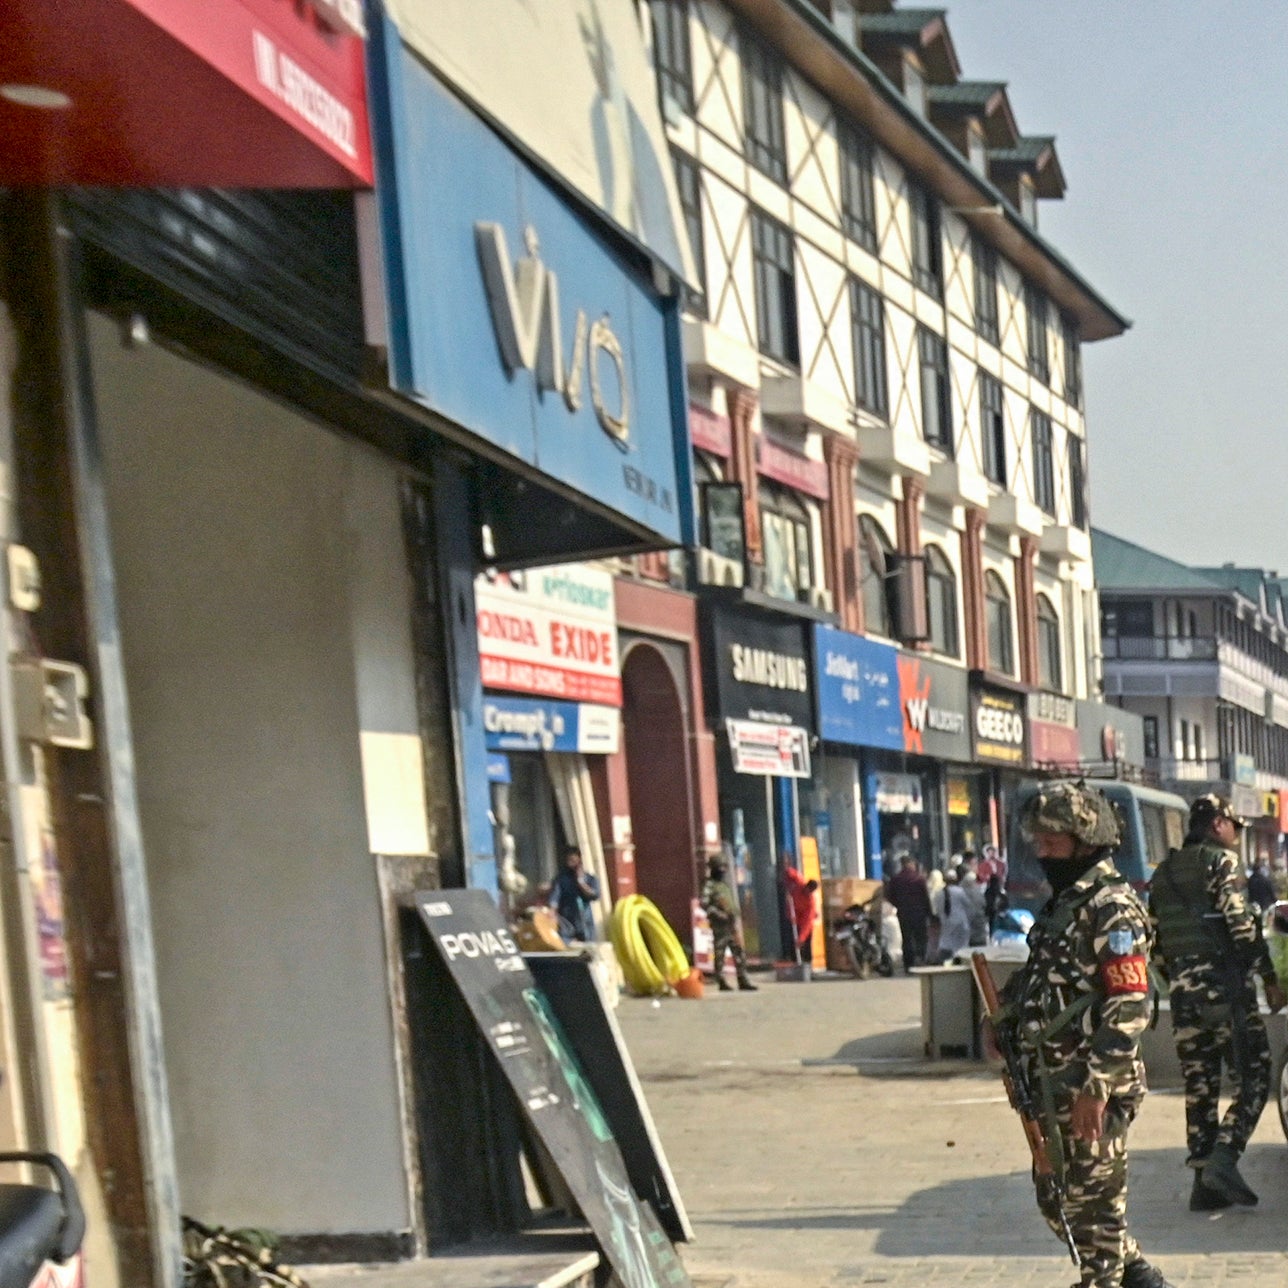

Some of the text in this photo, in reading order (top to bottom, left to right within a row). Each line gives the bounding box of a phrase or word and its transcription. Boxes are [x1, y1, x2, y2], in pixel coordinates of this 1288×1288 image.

[477, 610, 613, 667] ONDA EXIDE
[732, 643, 808, 693] SAMSUNG
[976, 705, 1024, 745] GEECO
